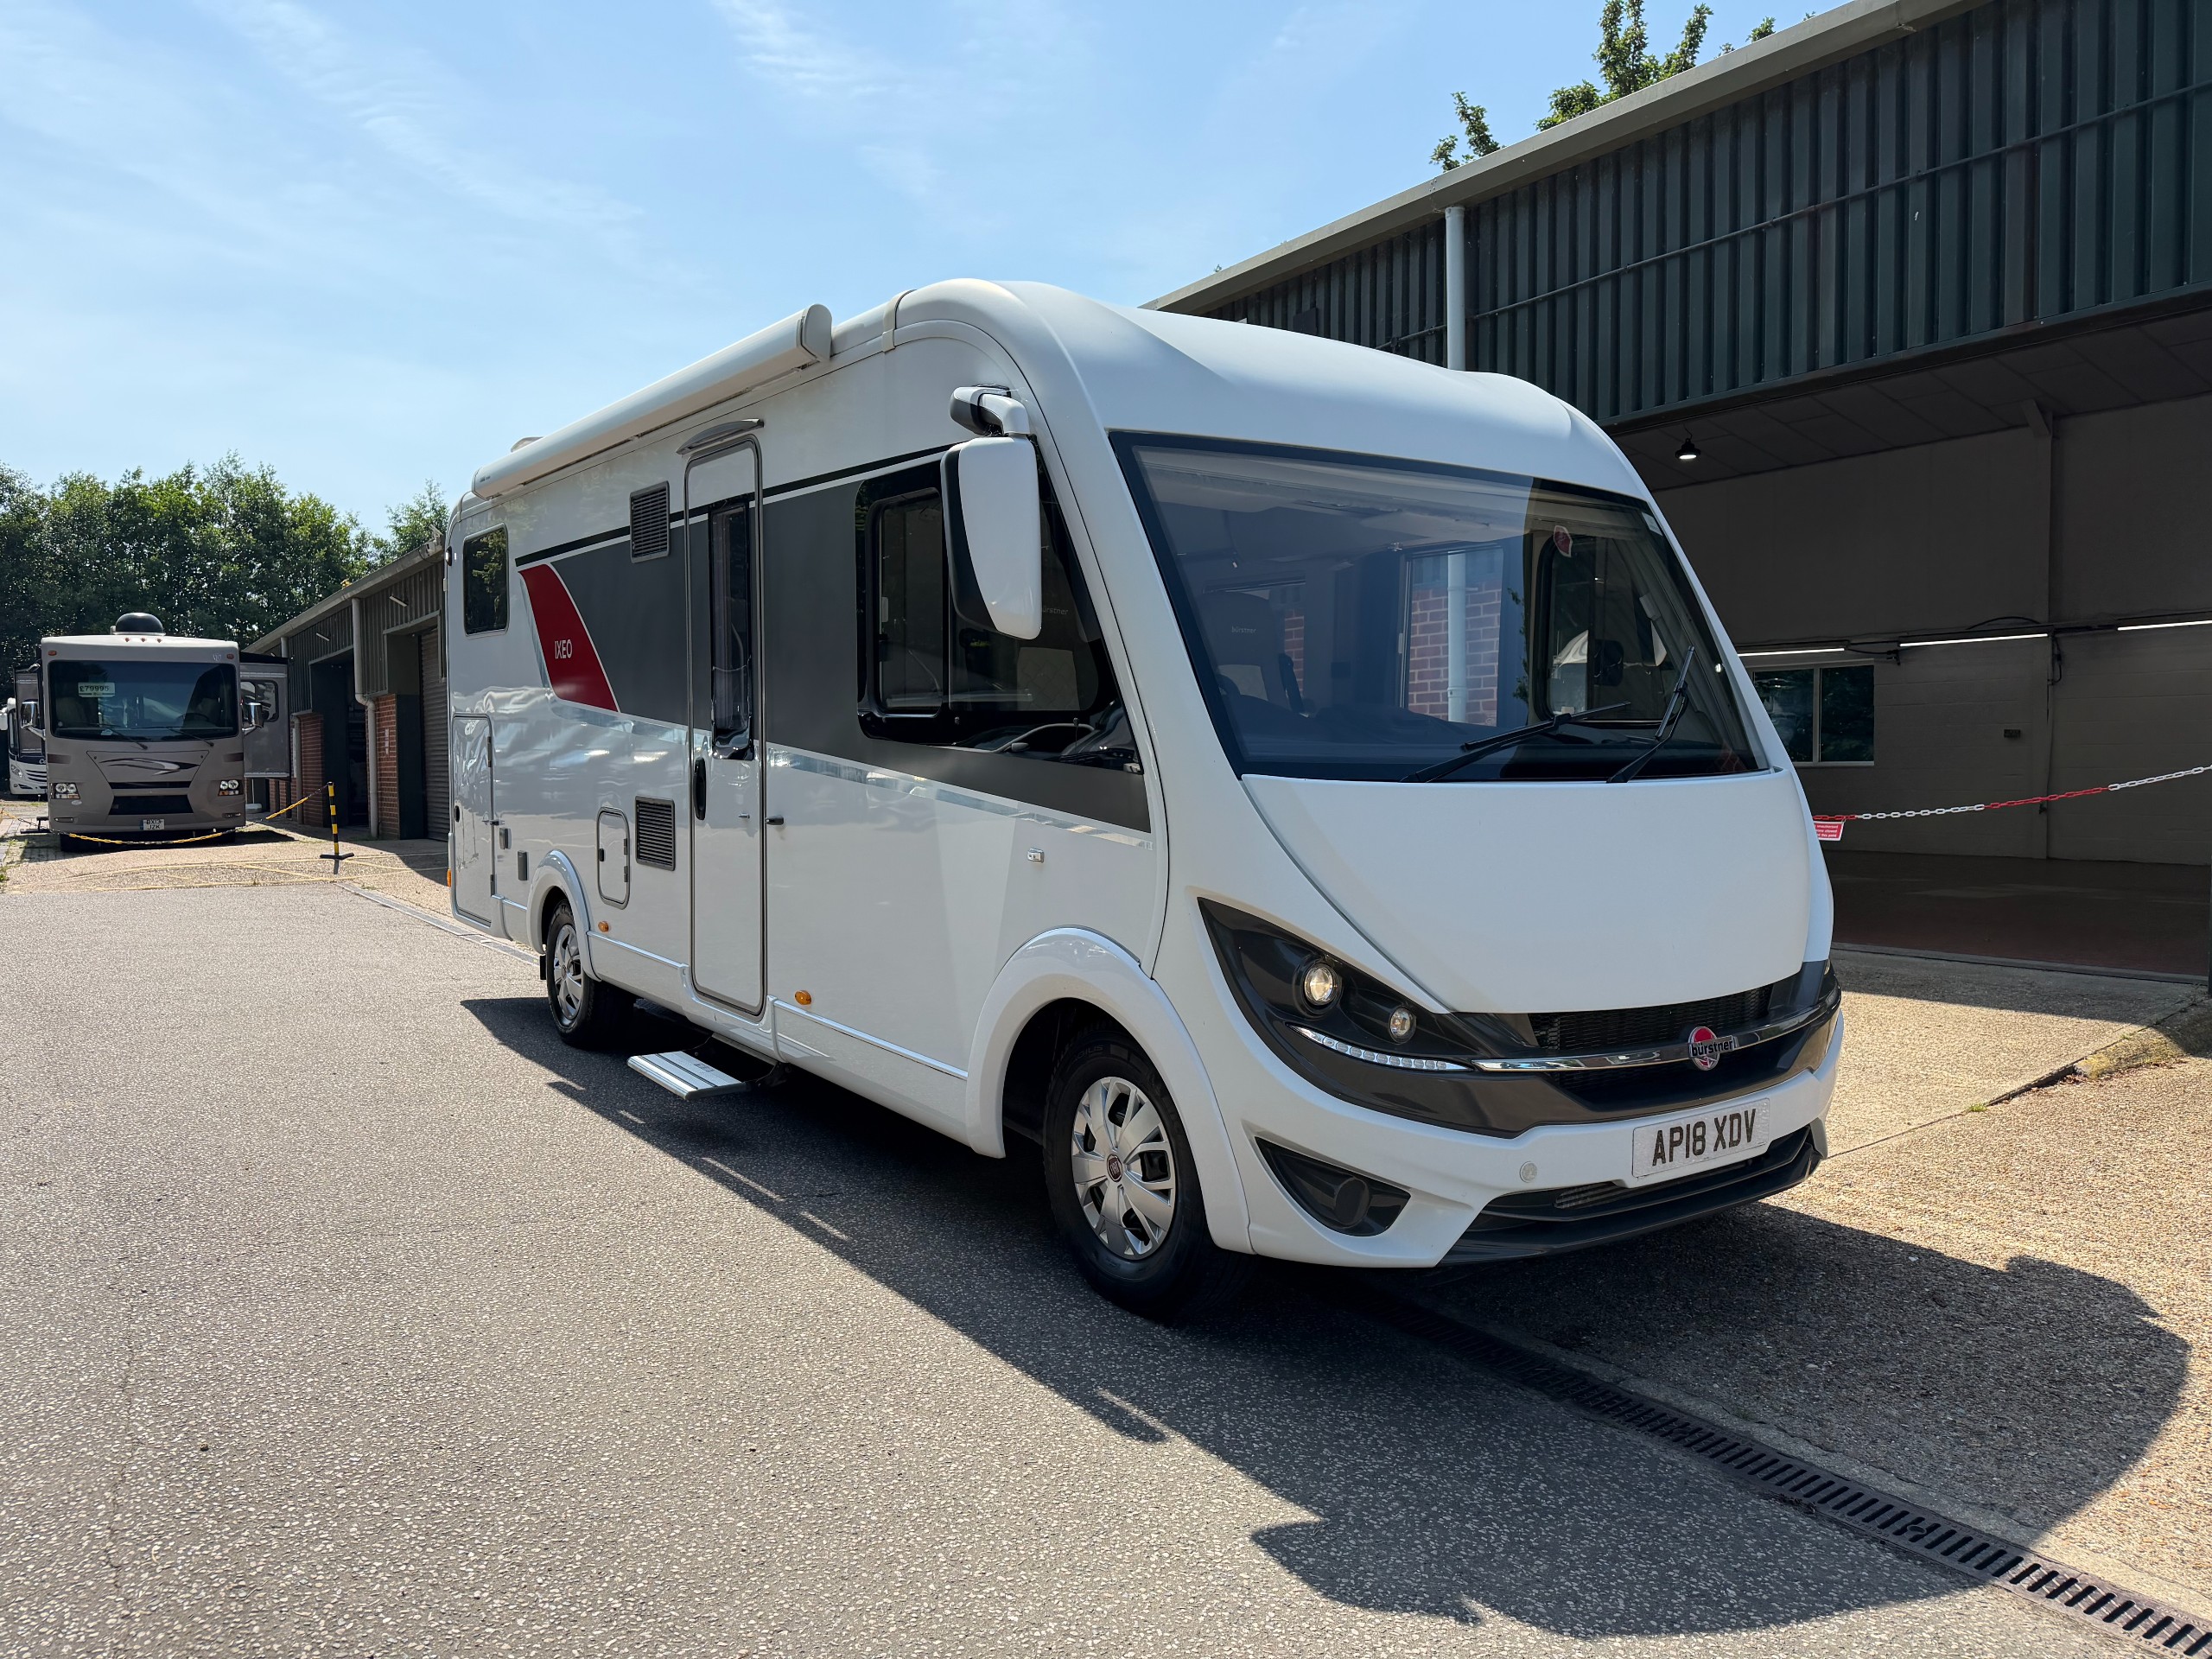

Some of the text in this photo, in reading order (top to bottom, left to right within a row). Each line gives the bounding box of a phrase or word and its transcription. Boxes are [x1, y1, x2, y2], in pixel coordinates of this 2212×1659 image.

[1042, 604, 1069, 615] ürstner
[554, 639, 573, 659] IXEO
[1692, 1039, 1733, 1056] bürstner
[1652, 1109, 1757, 1166] AP18 XDV
